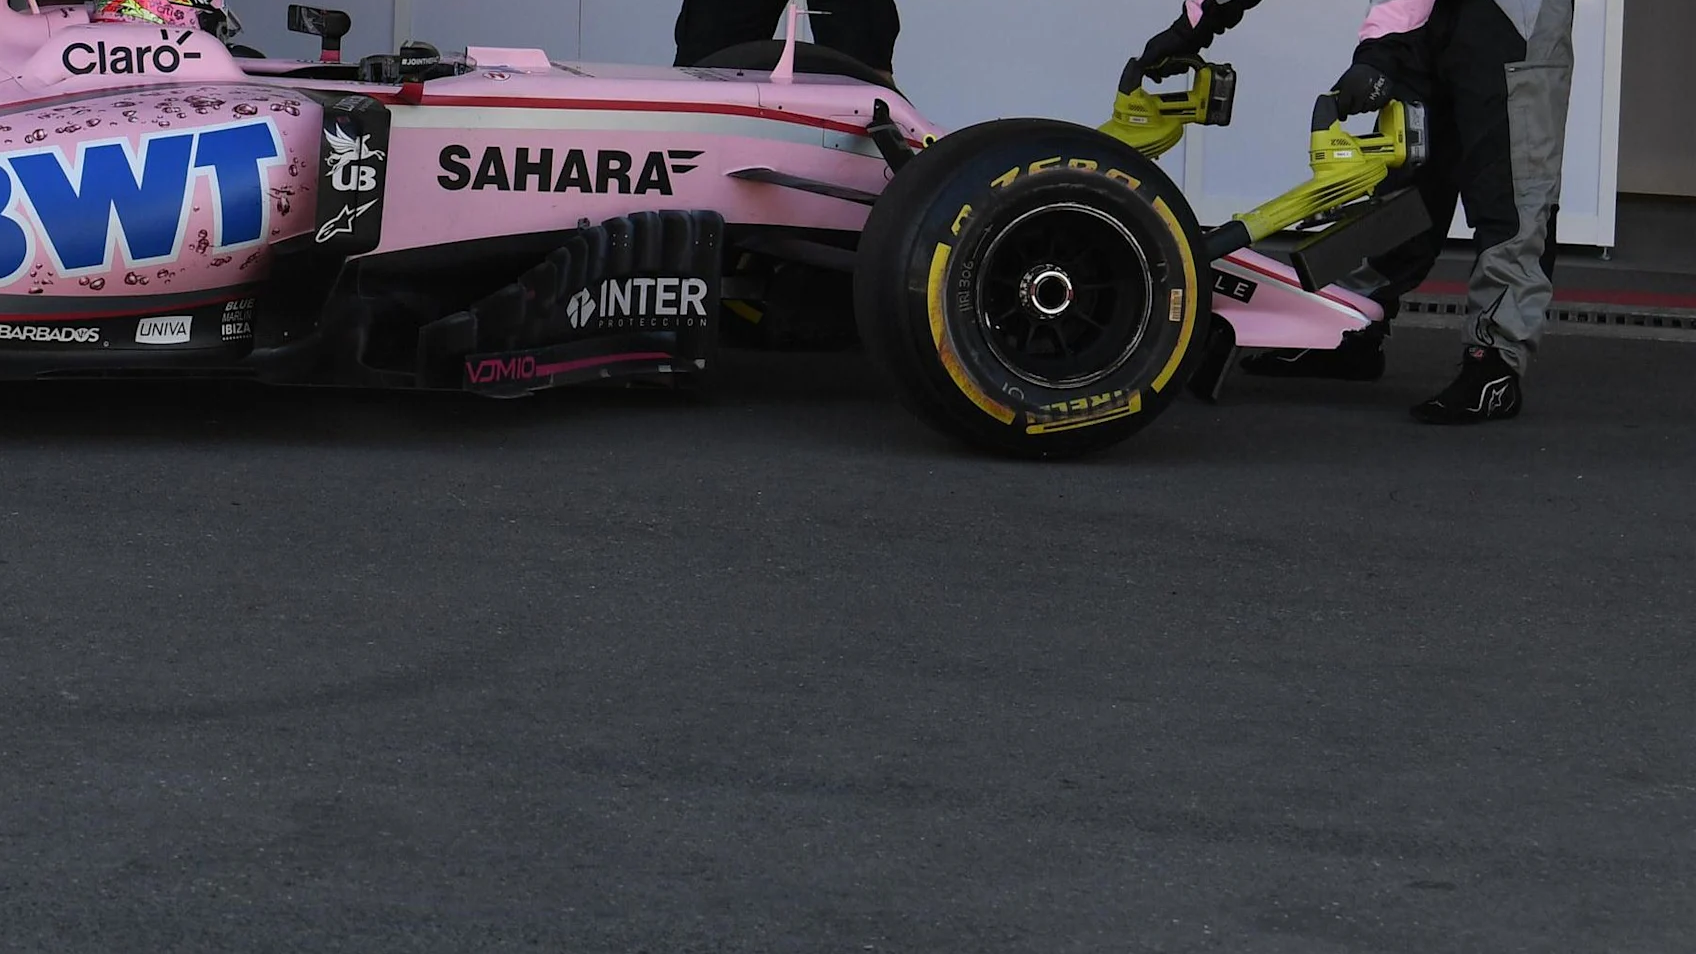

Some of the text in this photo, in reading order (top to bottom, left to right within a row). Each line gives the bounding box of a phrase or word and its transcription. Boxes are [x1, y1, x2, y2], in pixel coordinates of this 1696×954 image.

[62, 40, 181, 76] Claro
[332, 165, 377, 192] UB
[437, 144, 675, 196] SAHARA
[225, 299, 255, 312] BLUE
[599, 277, 708, 317] INTER
[139, 321, 187, 337] UNIVA
[221, 321, 251, 336] IBIZA
[599, 317, 708, 328] PROTECCION
[465, 356, 536, 384] VJM10
